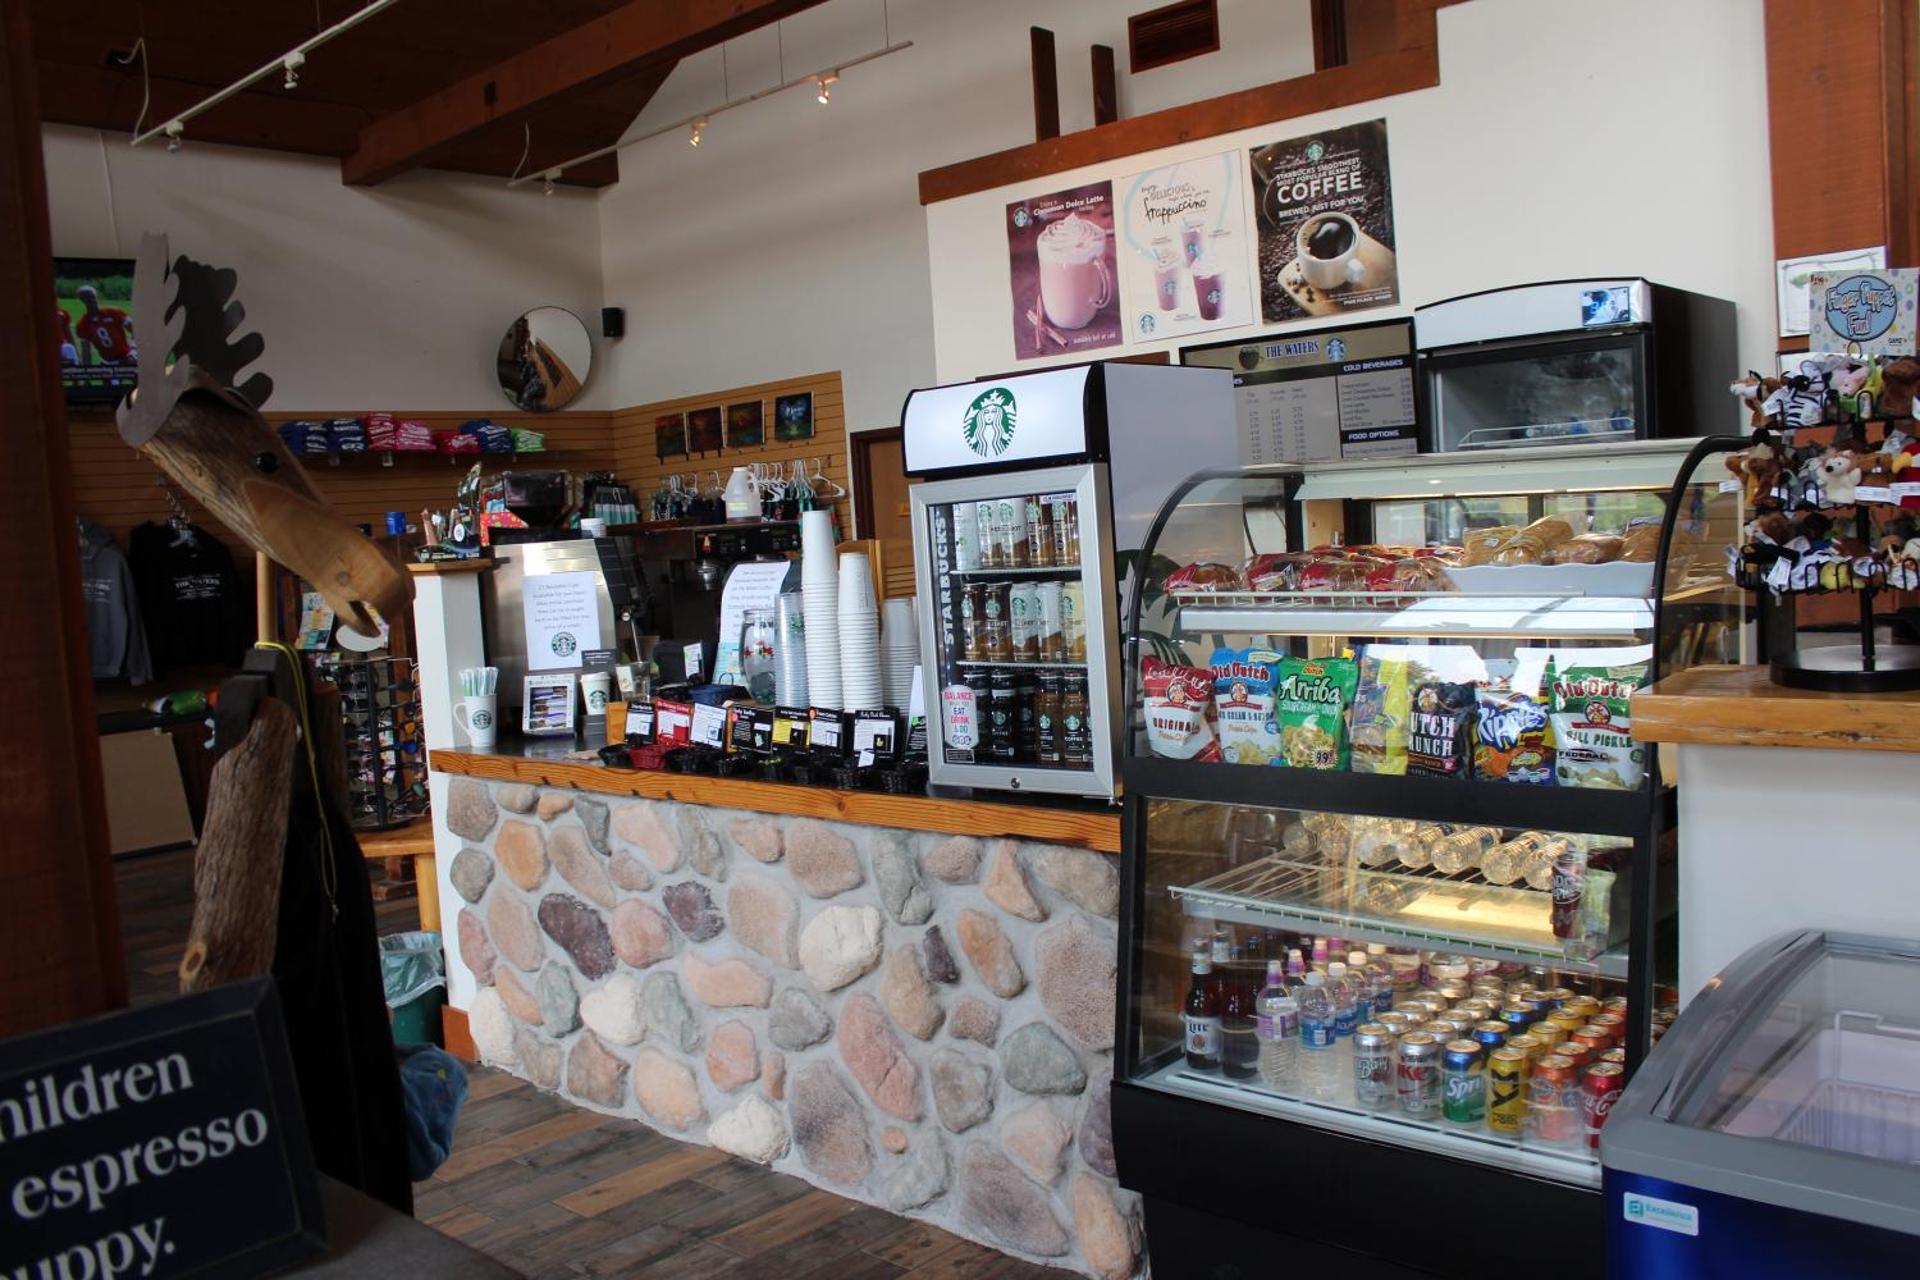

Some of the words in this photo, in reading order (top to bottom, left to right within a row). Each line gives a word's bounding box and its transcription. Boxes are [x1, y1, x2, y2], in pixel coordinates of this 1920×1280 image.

[1085, 194, 1105, 205] Latte
[1276, 170, 1364, 204] COFFEE
[1826, 286, 1861, 313] Finger
[1860, 280, 1897, 313] Puppet
[95, 326, 114, 349] 8
[1265, 346, 1284, 358] THE
[1285, 340, 1320, 355] WATERS
[1348, 433, 1370, 441] FOOD
[1369, 429, 1399, 439] OPTIONS
[935, 517, 955, 647] STARBUCKS
[1231, 661, 1270, 682] Dutch
[944, 691, 974, 701] BALANCE
[1279, 673, 1342, 706] Arriba
[953, 707, 967, 716] EAT
[1152, 717, 1200, 736] ORIGINAL
[1409, 711, 1456, 739] UTCH
[1408, 734, 1453, 757] RUNCH
[0, 1052, 195, 1143] hildren
[1446, 1075, 1482, 1104] Spri
[11, 1108, 269, 1220] espresso
[0, 1216, 176, 1280] uppy.
